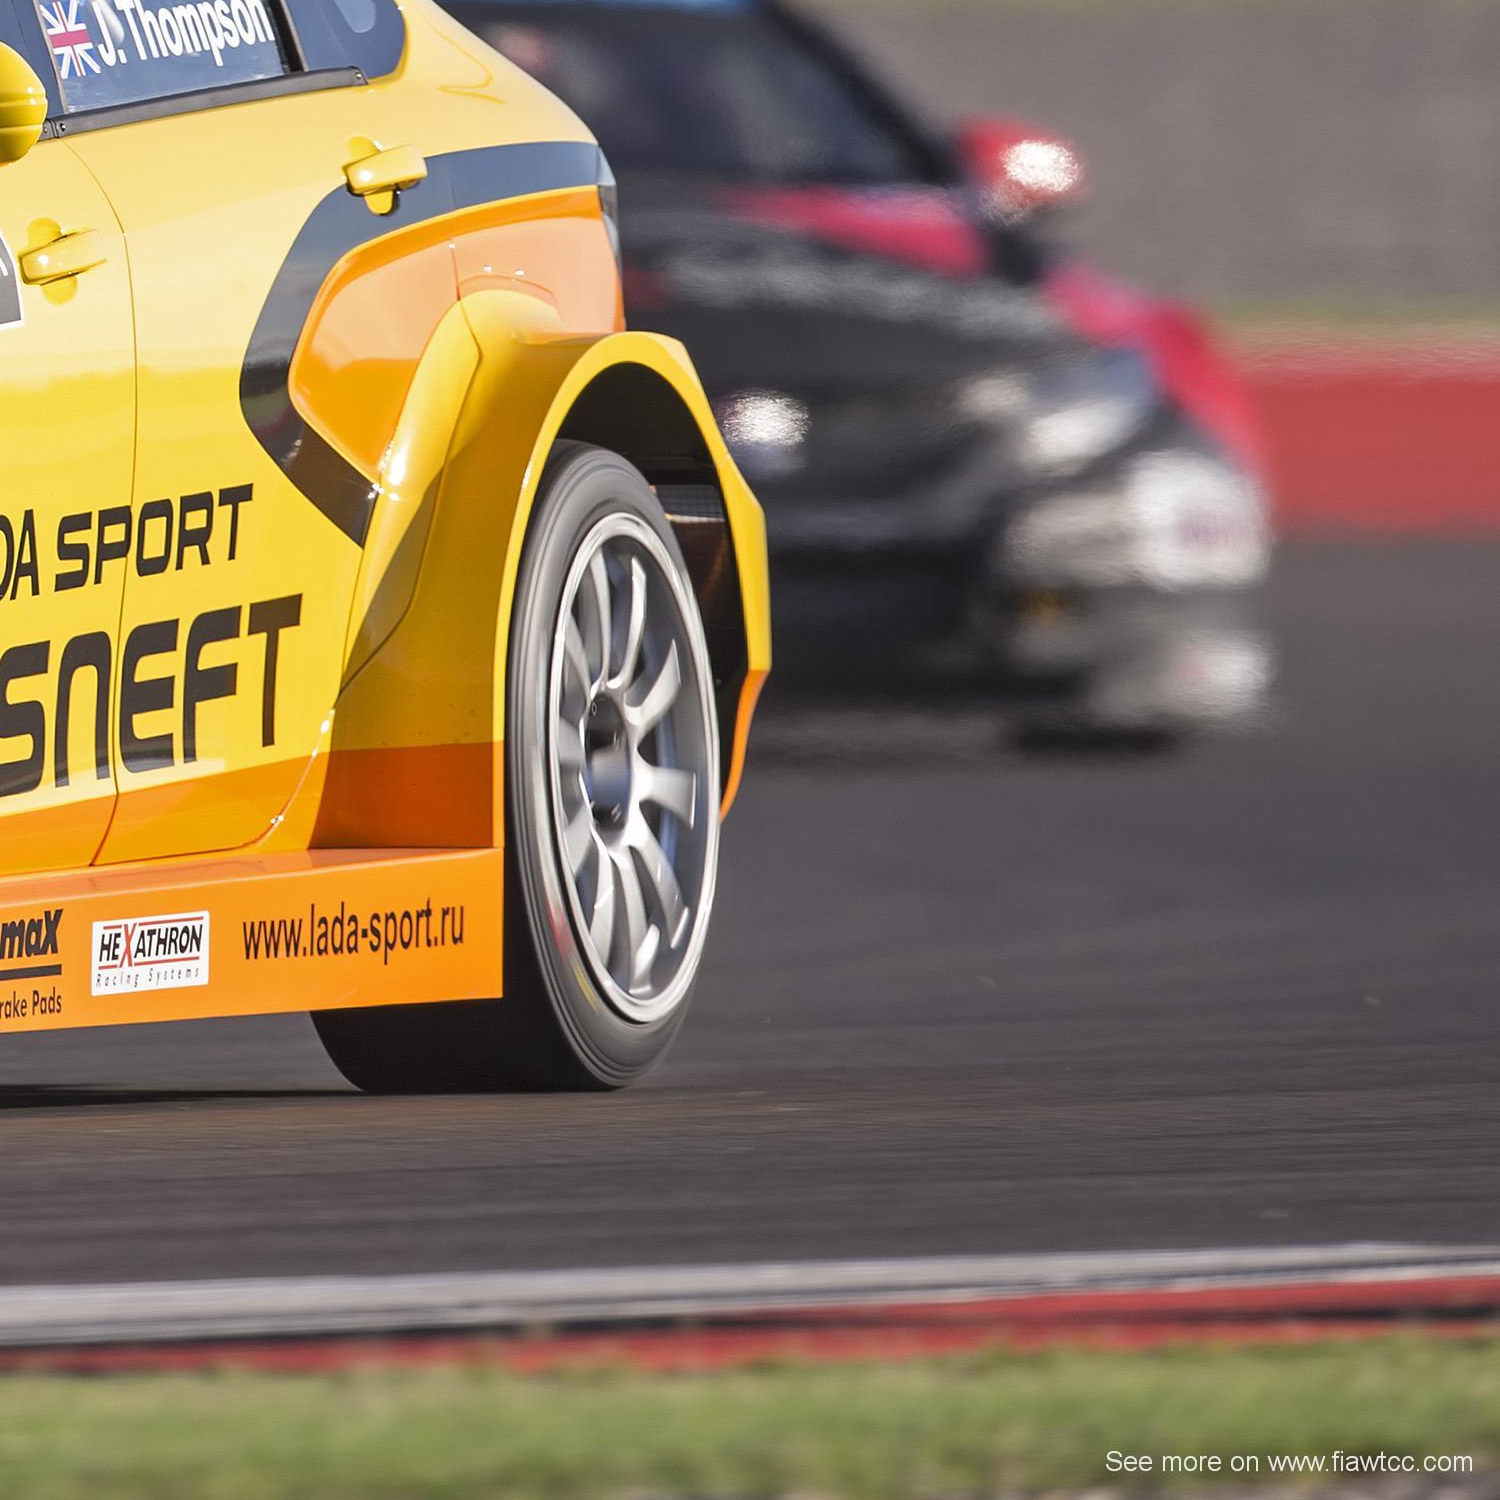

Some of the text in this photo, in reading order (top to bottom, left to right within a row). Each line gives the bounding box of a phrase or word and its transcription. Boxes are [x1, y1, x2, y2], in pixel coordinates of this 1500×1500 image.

[92, 1, 128, 68] J.
[55, 483, 253, 592] SPORT
[99, 923, 203, 968] HEXATHRON
[243, 898, 465, 965] www.lada-sport.ru
[32, 986, 62, 1015] Pads
[96, 967, 199, 987] Racing Systems
